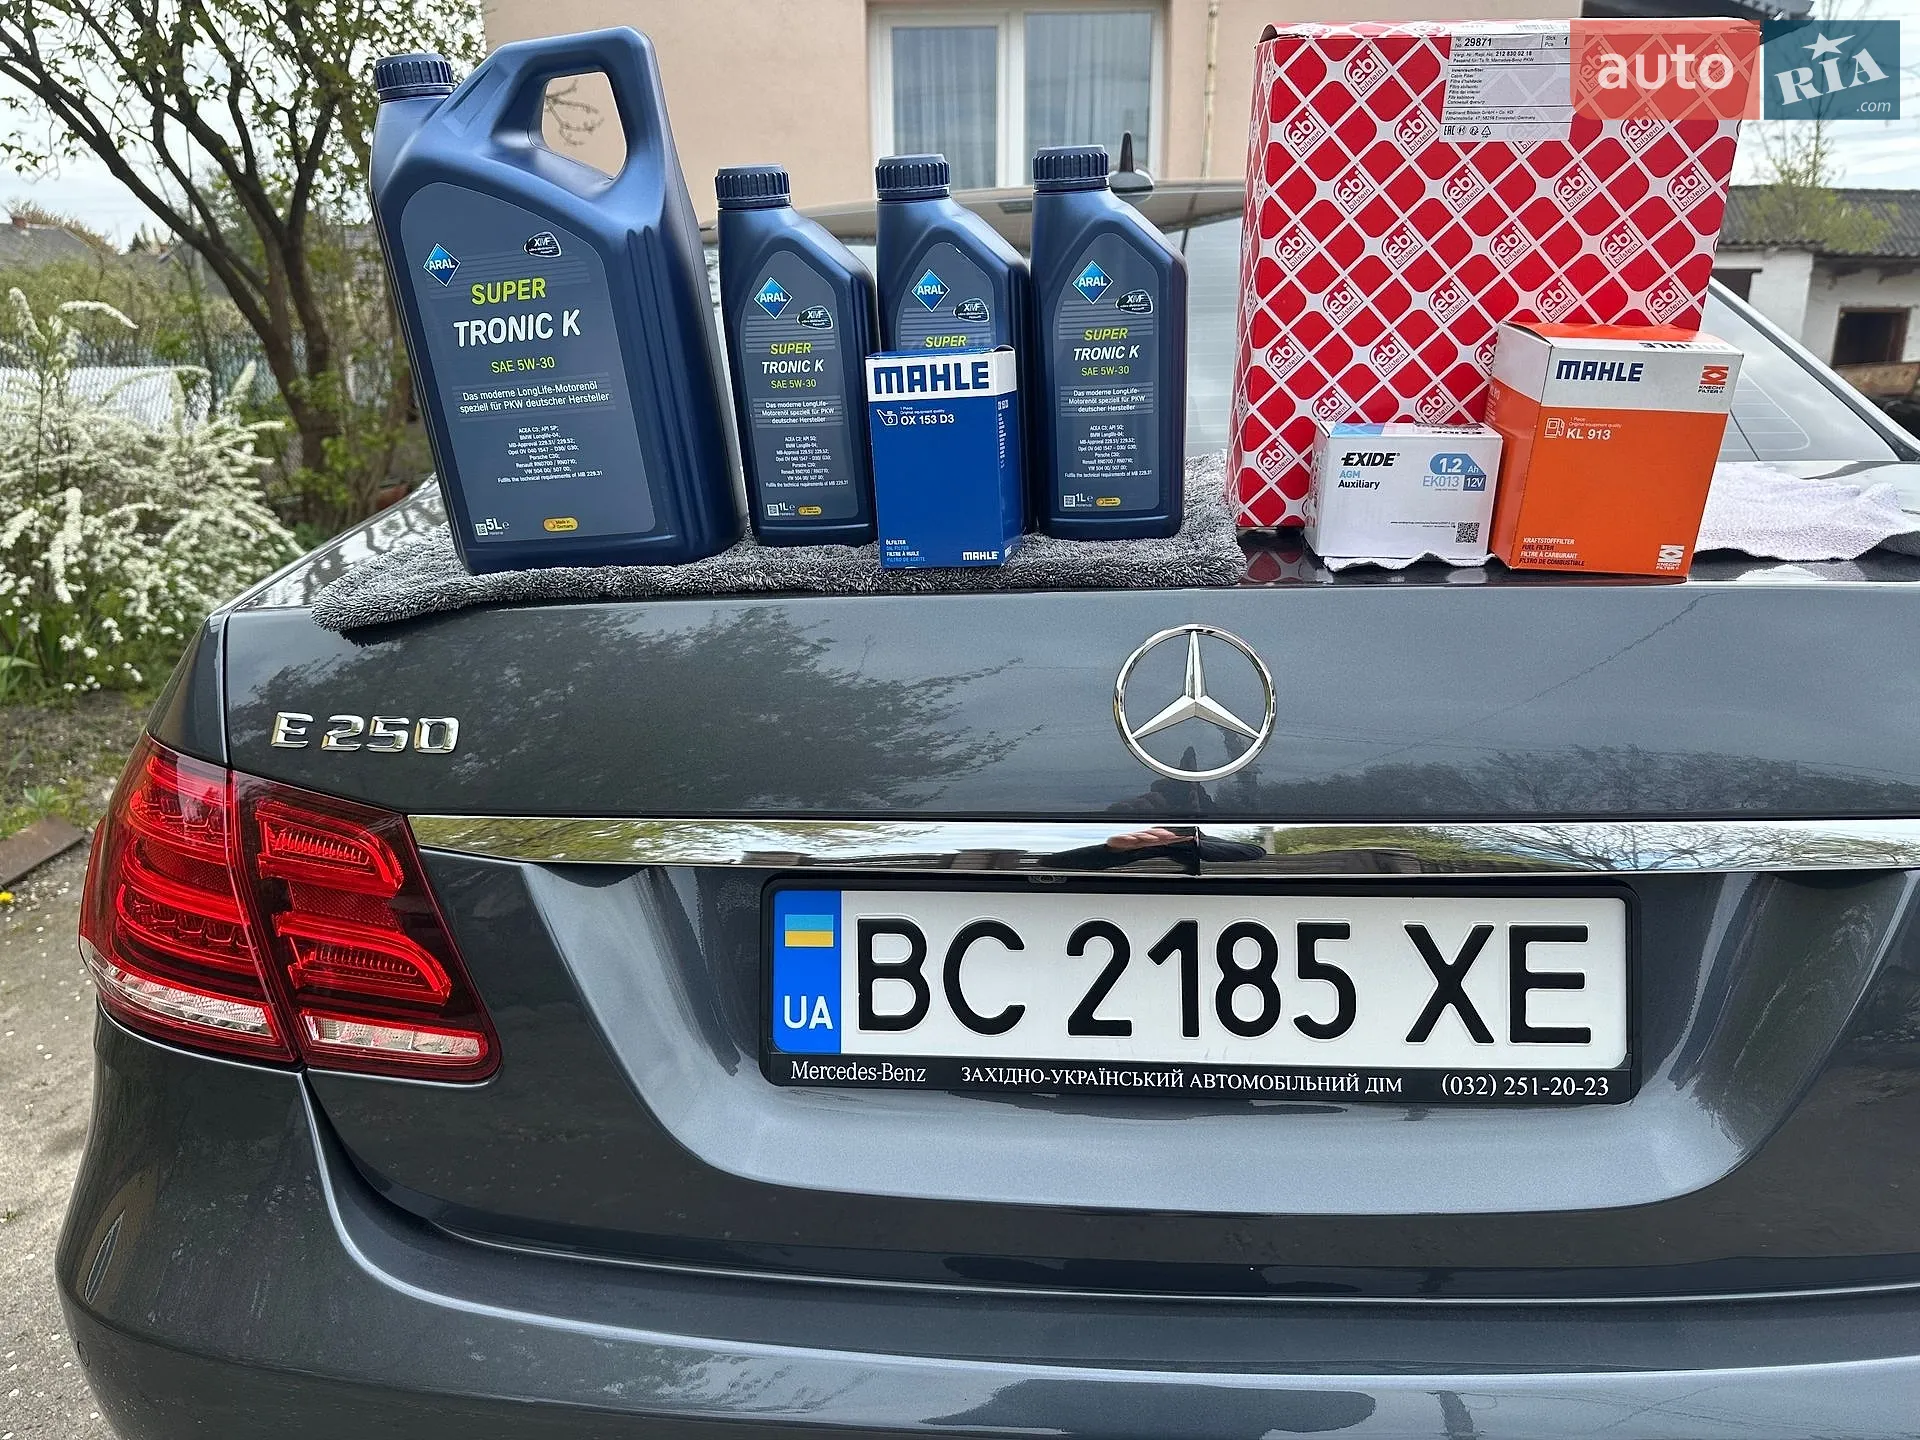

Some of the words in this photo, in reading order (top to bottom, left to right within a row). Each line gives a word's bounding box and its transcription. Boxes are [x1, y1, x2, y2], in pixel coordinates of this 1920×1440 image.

[1464, 37, 1492, 47] 29871
[1563, 36, 1569, 45] 1
[1360, 68, 1384, 92] bilstein
[1408, 128, 1433, 152] bilstein
[1635, 125, 1660, 149] bilstein
[1348, 187, 1371, 211] bilstein
[1456, 185, 1482, 209] bilstein
[1680, 184, 1708, 208] bilstein
[1397, 244, 1419, 266] bilstein
[1614, 242, 1639, 265] bilstein
[429, 258, 455, 270] ARAL
[917, 284, 945, 295] ARAL
[1078, 276, 1108, 287] ARAL
[471, 277, 546, 305] SUPER
[760, 293, 787, 303] ARAL
[1337, 300, 1359, 321] bilstein
[1549, 298, 1574, 320] bilstein
[453, 312, 554, 348] TRONIC
[562, 309, 581, 337] K
[1084, 327, 1129, 341] SUPER
[770, 342, 812, 355] SUPER
[925, 335, 967, 348] SUPER
[1073, 346, 1125, 361] TRONIC
[1128, 345, 1140, 359] K
[491, 360, 515, 374] SAE
[517, 356, 555, 372] 5W-30
[761, 360, 811, 374] TRONIC
[814, 358, 825, 372] K
[1081, 367, 1099, 377] SAE
[1100, 365, 1130, 376] 5W-30
[1279, 355, 1301, 376] bilstein
[1555, 360, 1644, 382] MAHLE
[770, 380, 788, 389] SAE
[789, 379, 817, 388] 5W-30
[873, 361, 990, 395] MAHLE
[462, 392, 479, 401] Das
[480, 389, 516, 400] moderne
[516, 380, 598, 399] LongLife-Motorenöl
[460, 402, 489, 415] speziell
[489, 401, 502, 411] für
[504, 400, 524, 410] PKW
[525, 395, 566, 408] deutscher
[569, 392, 610, 404] Hersteller
[900, 415, 917, 426] OX
[919, 414, 938, 425] 153
[940, 413, 955, 424] D3
[1566, 428, 1584, 440] KL
[1587, 429, 1611, 440] 913
[1270, 456, 1291, 478] bilstein
[1341, 452, 1396, 467] EXIDE
[1439, 457, 1463, 473] 1.2
[1467, 465, 1479, 473] Ah
[1339, 470, 1361, 479] AGM
[1422, 475, 1460, 487] EK013
[1466, 477, 1484, 488] 12V
[1338, 480, 1381, 491] Auxiliary
[1075, 493, 1086, 502] 1L
[779, 502, 789, 511] 1L
[485, 518, 502, 531] 5L
[962, 551, 998, 561] MAHLE
[270, 711, 314, 749] E
[320, 714, 460, 754] 250
[856, 917, 1026, 1036] BC
[1065, 919, 1360, 1041] 2185
[1403, 922, 1594, 1046] XE
[783, 996, 834, 1031] UA
[791, 1060, 927, 1083] Mercedes-Benz
[961, 1066, 1184, 1089] ЗАХІДНО-УКРАЇНСЬКИЙ
[1190, 1072, 1361, 1093] АВТОМОБІЛЬНИЙ
[1364, 1077, 1403, 1094] ДІМ
[1441, 1072, 1498, 1097] (032)
[1503, 1075, 1609, 1097] 251-20-23
